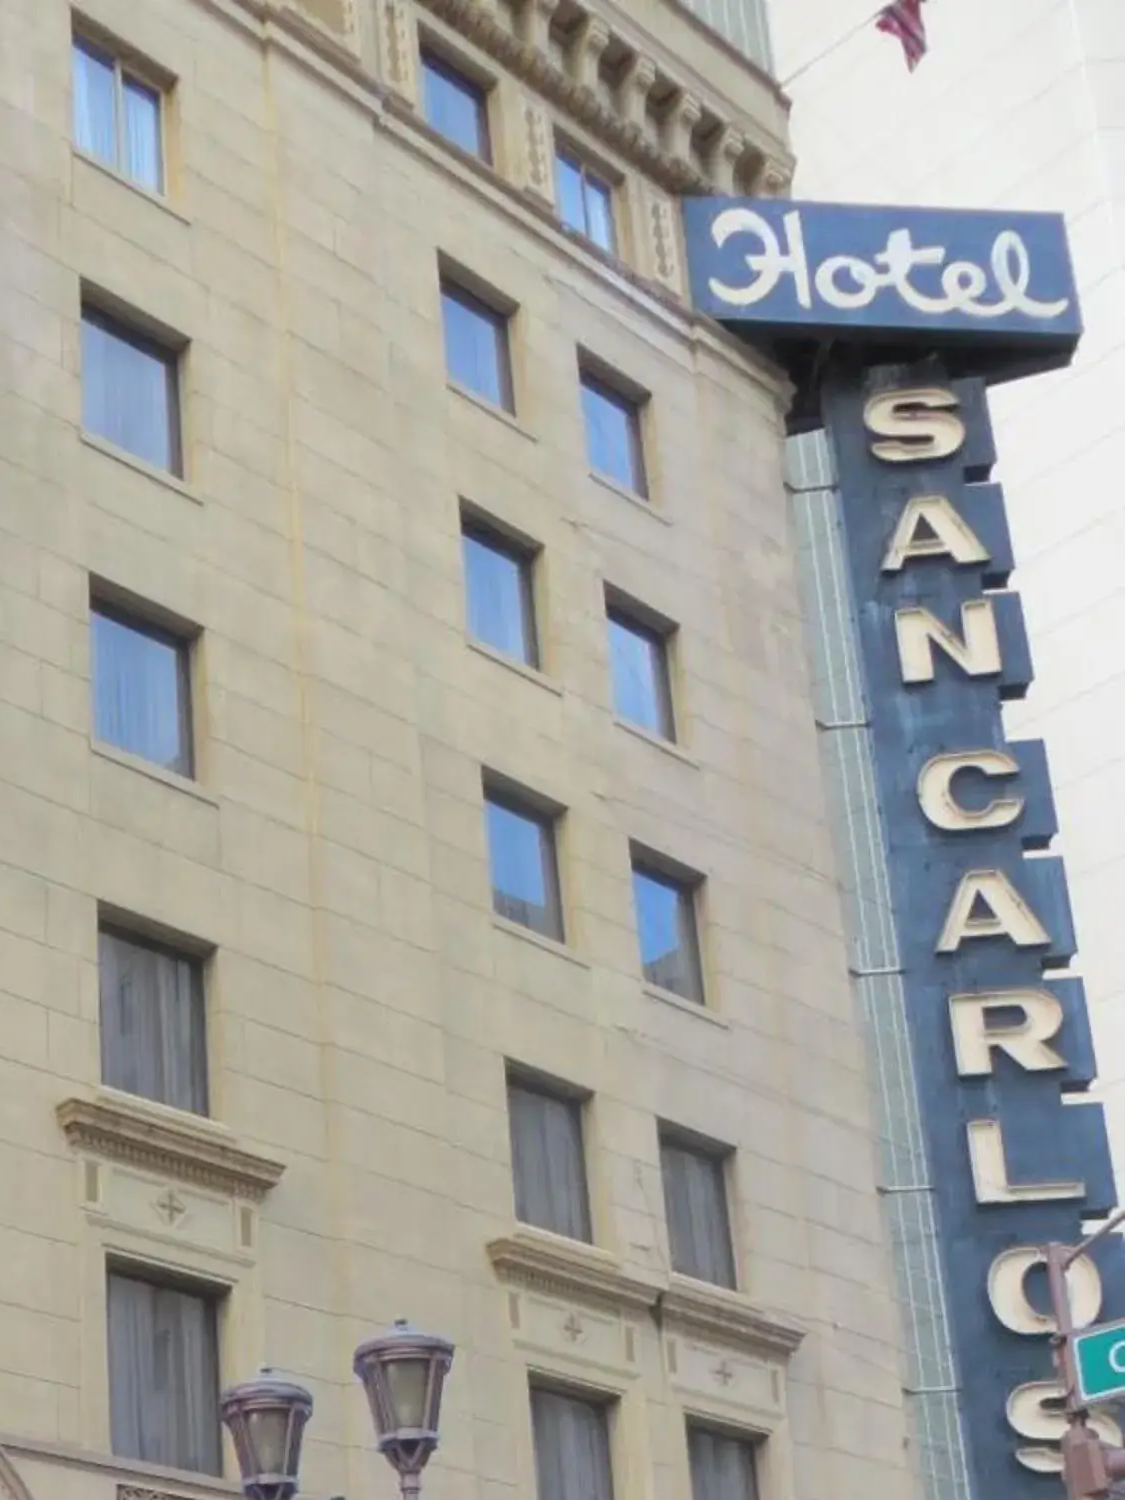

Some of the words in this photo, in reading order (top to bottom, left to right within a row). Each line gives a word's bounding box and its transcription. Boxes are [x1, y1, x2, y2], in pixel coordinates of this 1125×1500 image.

[707, 207, 1070, 318] Hotel
[863, 387, 1003, 684] SAN
[917, 748, 1123, 1474] CARLOS
